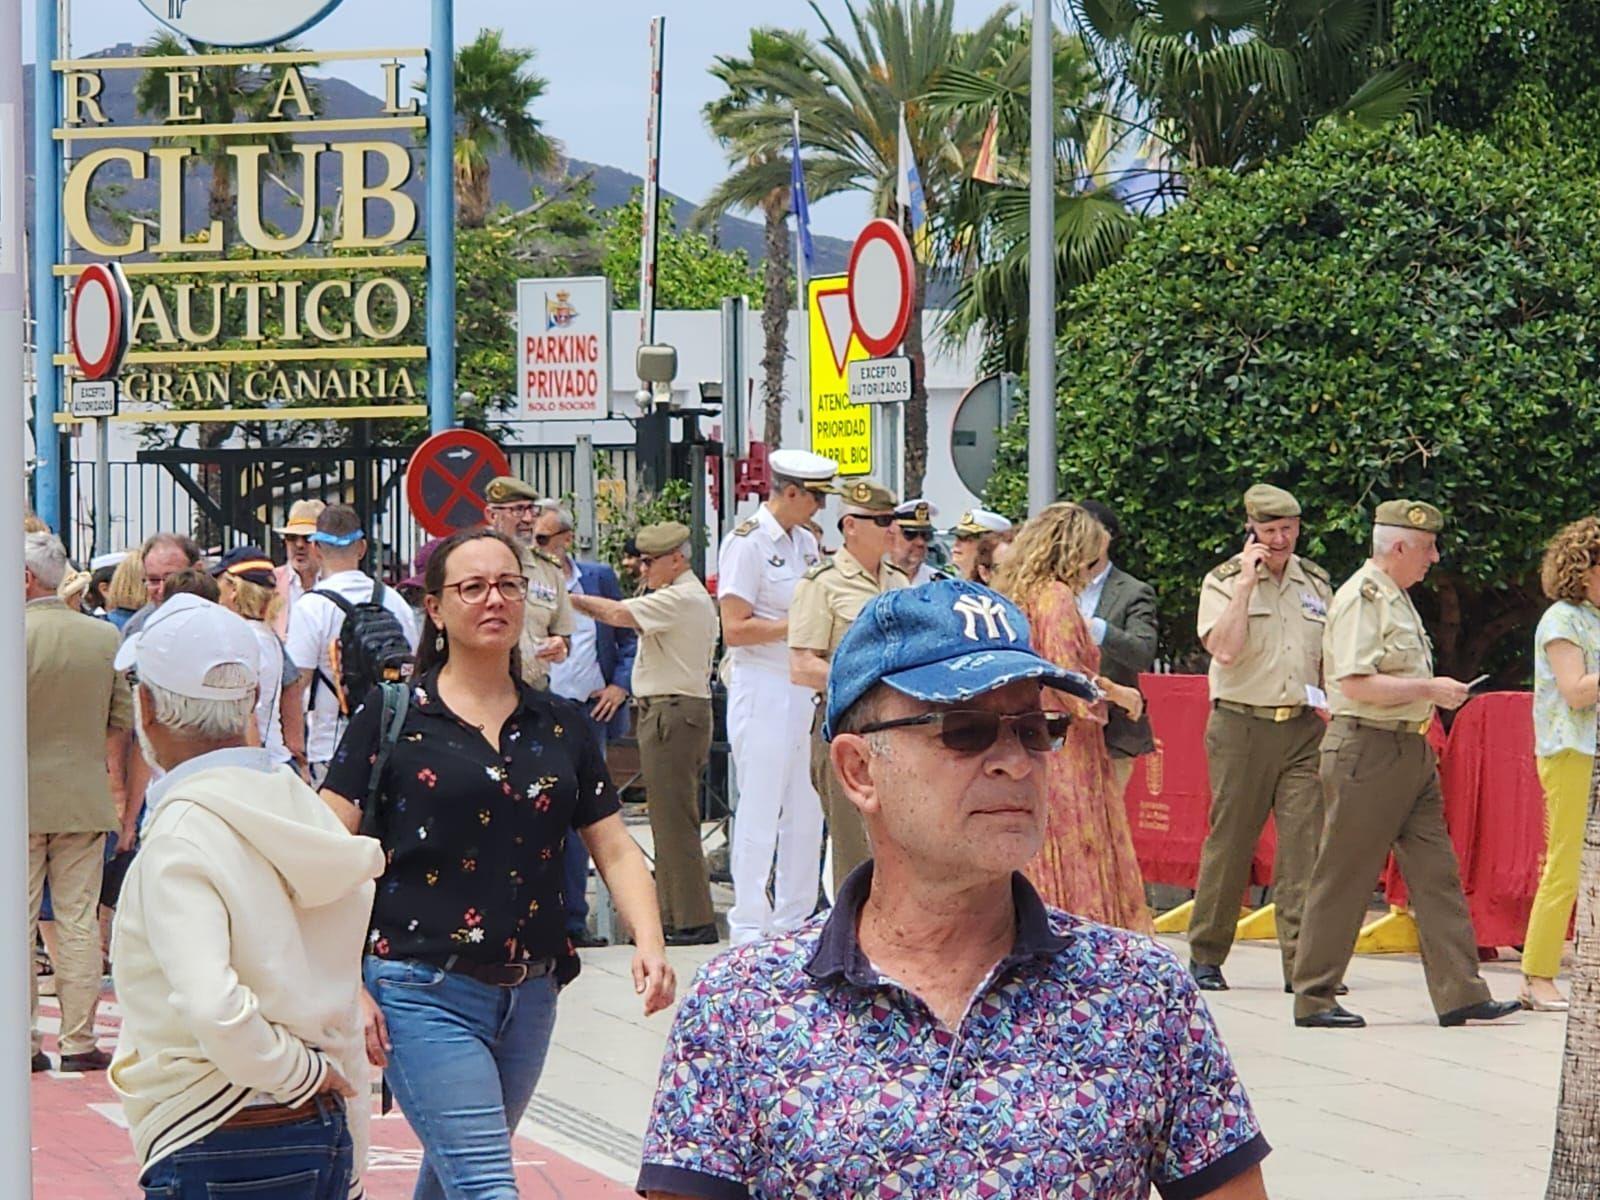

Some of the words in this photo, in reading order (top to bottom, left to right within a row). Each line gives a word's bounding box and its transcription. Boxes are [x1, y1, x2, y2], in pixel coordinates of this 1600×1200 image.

[65, 63, 418, 123] REAL
[63, 142, 417, 256] CLUB
[130, 277, 412, 345] AUTICO
[526, 334, 598, 364] PARKING
[124, 371, 230, 401] GRAN
[244, 367, 416, 400] CANARIA
[527, 369, 598, 398] PRIVADO
[861, 365, 897, 380] EXCEPTO
[852, 381, 907, 395] AUTORIZADOS
[527, 402, 556, 412] SOLO
[818, 393, 864, 411] ATENC
[817, 419, 866, 438] PRIORIDAD
[850, 445, 868, 464] BICI
